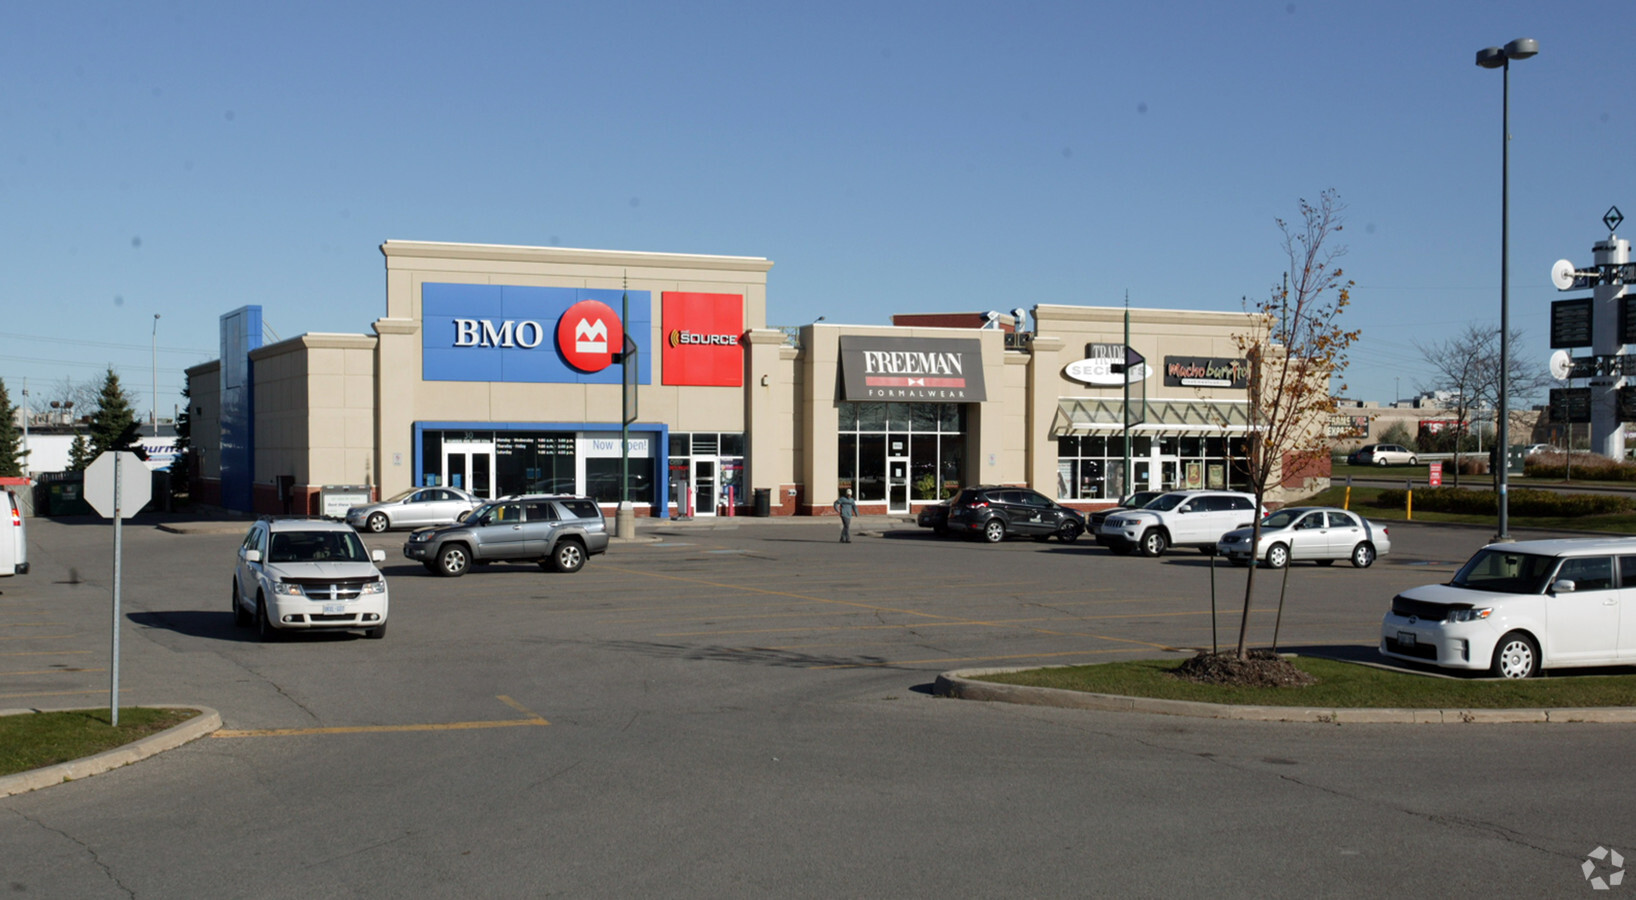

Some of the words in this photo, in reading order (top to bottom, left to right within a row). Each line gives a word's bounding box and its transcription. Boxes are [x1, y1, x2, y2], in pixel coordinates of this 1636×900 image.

[455, 319, 543, 348] BMO
[680, 333, 738, 345] SOURCE
[1092, 345, 1125, 365] TRADE
[862, 350, 962, 375] FREEMAN
[1071, 366, 1144, 376] SECTS
[868, 389, 965, 398] FORMALWEAR
[592, 440, 614, 450] Now
[620, 440, 647, 453] pen!
